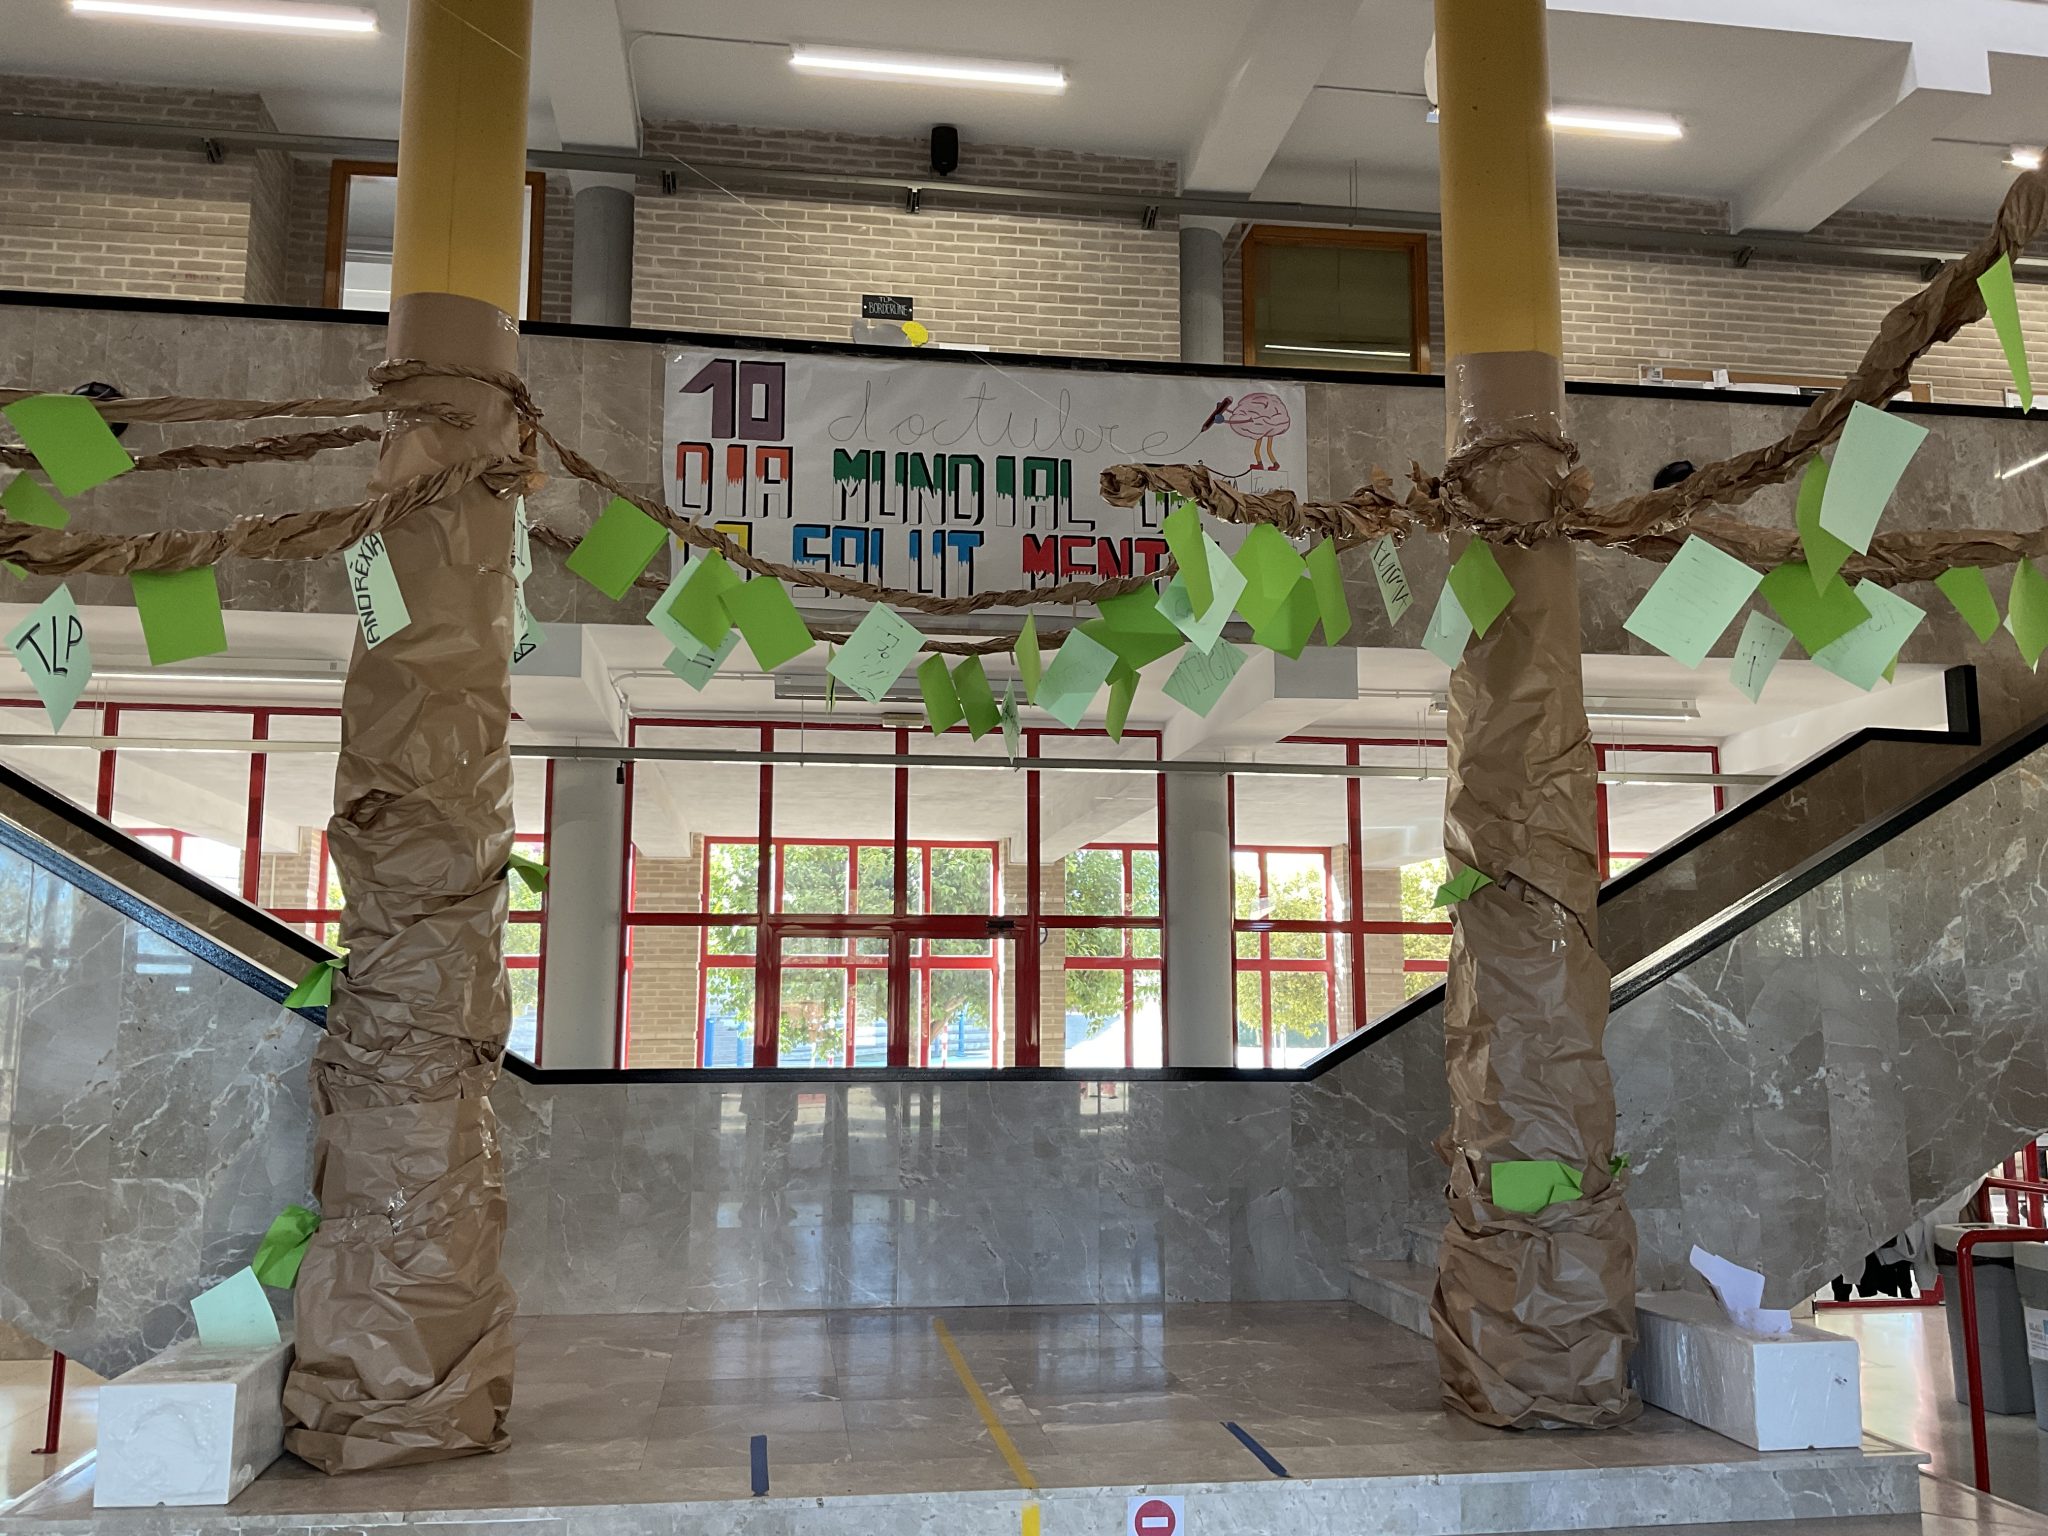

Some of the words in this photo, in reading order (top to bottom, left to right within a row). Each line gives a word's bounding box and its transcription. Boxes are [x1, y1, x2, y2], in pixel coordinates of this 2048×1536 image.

[868, 302, 908, 316] BORDERLINE
[678, 358, 786, 441] 10
[676, 441, 793, 519] DIA
[832, 447, 1096, 531] MUNDIAL
[792, 523, 984, 599] SALUT
[16, 614, 83, 678] TLP
